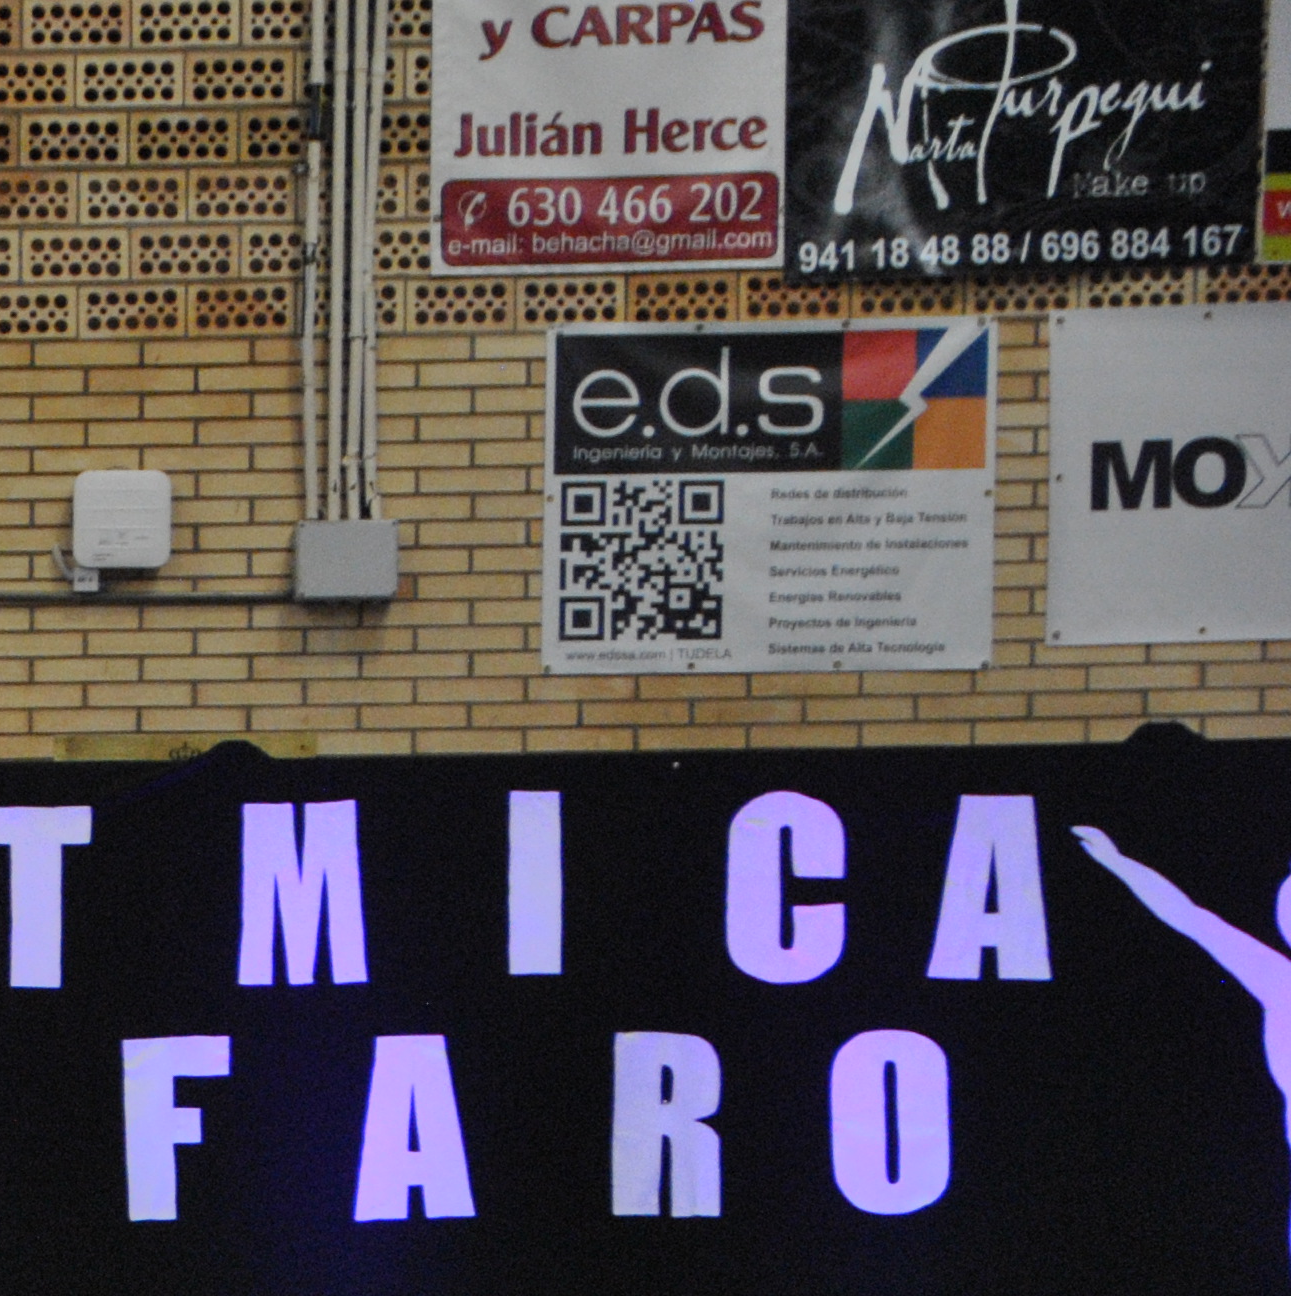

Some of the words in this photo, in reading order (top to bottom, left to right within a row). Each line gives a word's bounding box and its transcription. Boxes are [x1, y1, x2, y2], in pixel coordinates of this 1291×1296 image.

[479, 19, 513, 61] y
[531, 0, 766, 48] CARPAS
[454, 111, 603, 158] Julián
[623, 107, 768, 154] Herce
[507, 187, 583, 227] 630
[597, 184, 673, 225] 466
[689, 181, 764, 223] 202
[447, 232, 523, 256] e-mail:
[531, 228, 772, 256] behacha@gmail.com
[798, 241, 856, 273] 941
[872, 238, 910, 269] 18
[920, 235, 961, 266] 48
[971, 232, 1011, 263] 88
[1040, 230, 1102, 261] 696
[1111, 228, 1170, 259] 884
[1182, 224, 1244, 256] 167
[573, 346, 825, 438] e.d.s
